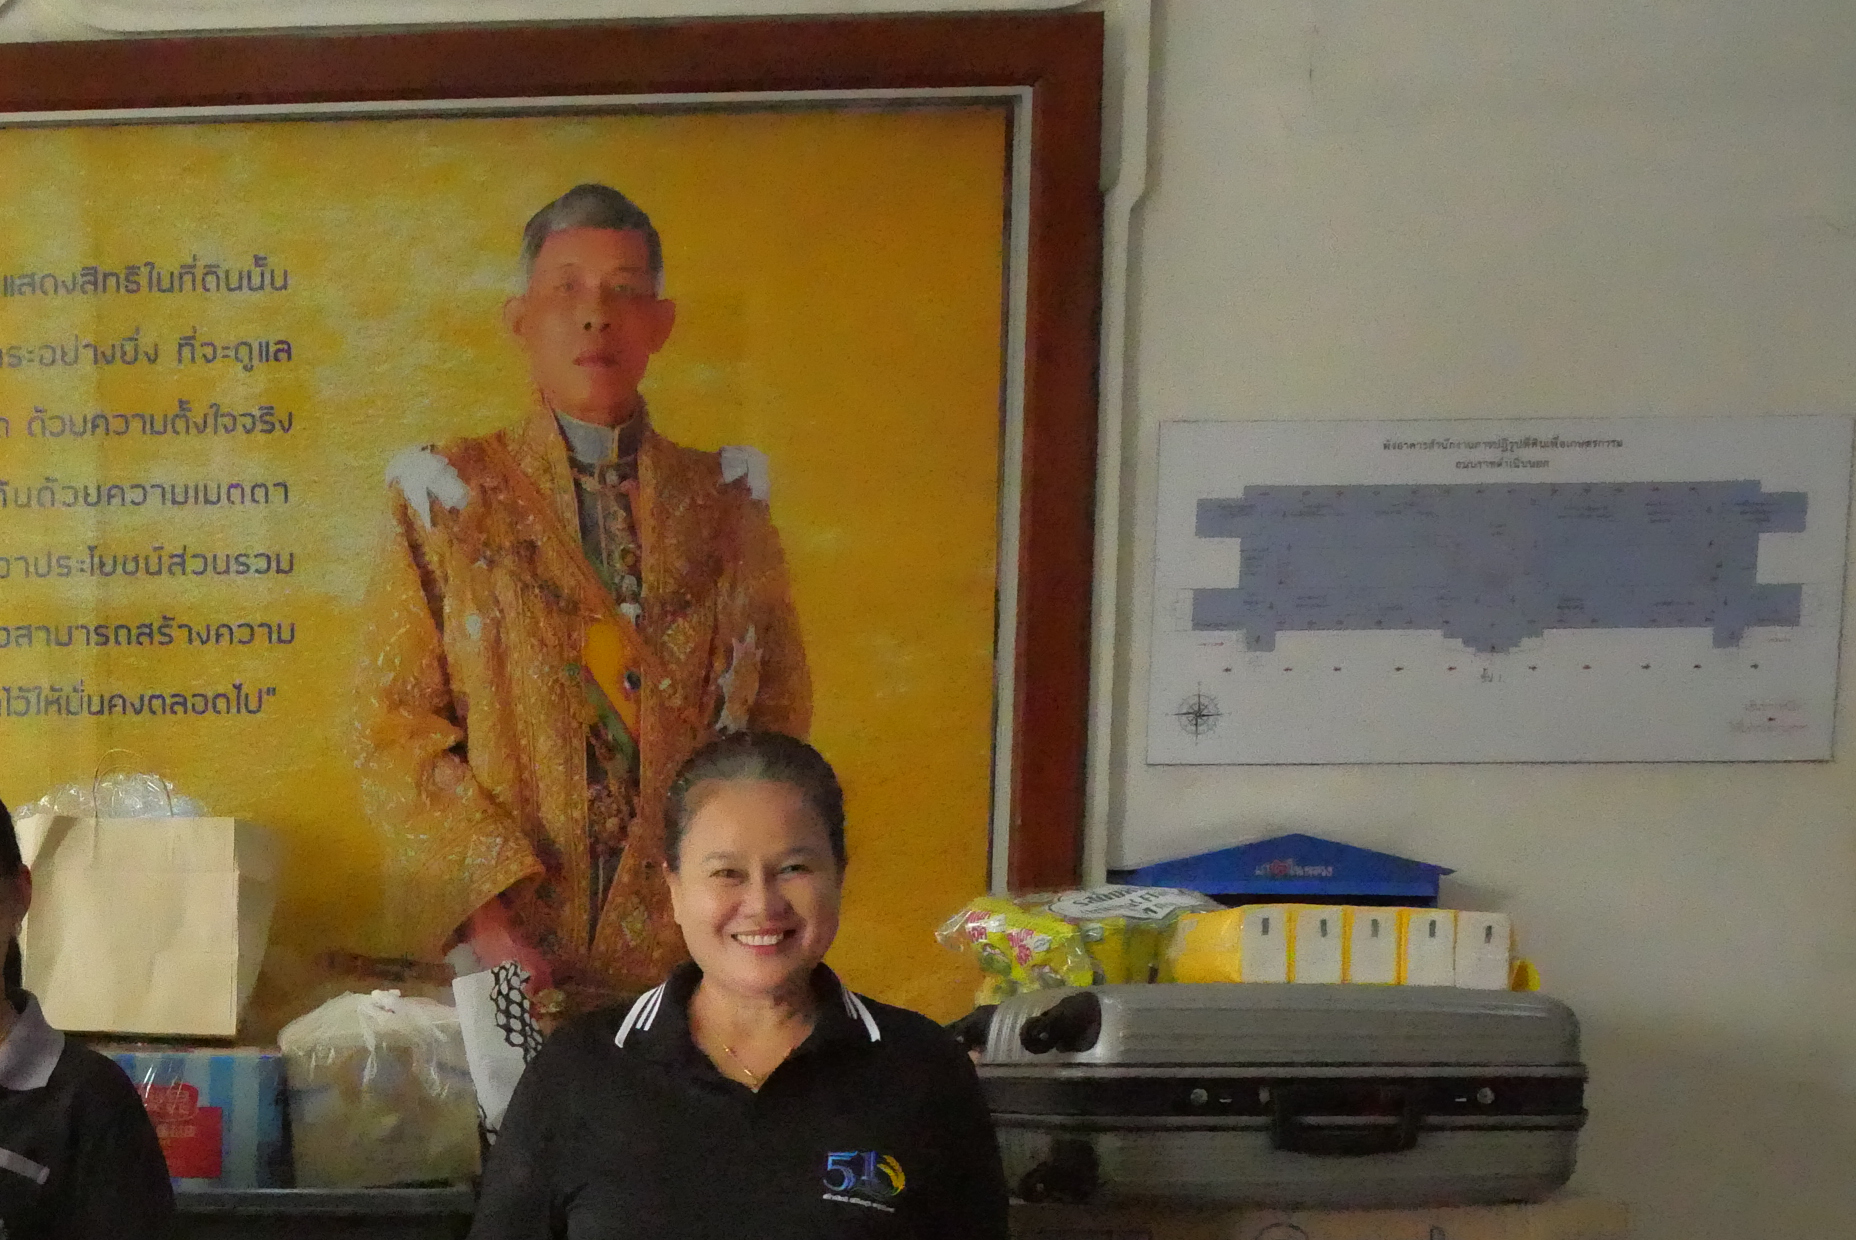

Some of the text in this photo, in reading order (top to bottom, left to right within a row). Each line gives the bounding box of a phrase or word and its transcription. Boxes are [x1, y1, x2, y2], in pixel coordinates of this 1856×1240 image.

[176, 326, 294, 373] ที่จะดูแล
[26, 398, 294, 438] ด้วยความตั้งใจจริง
